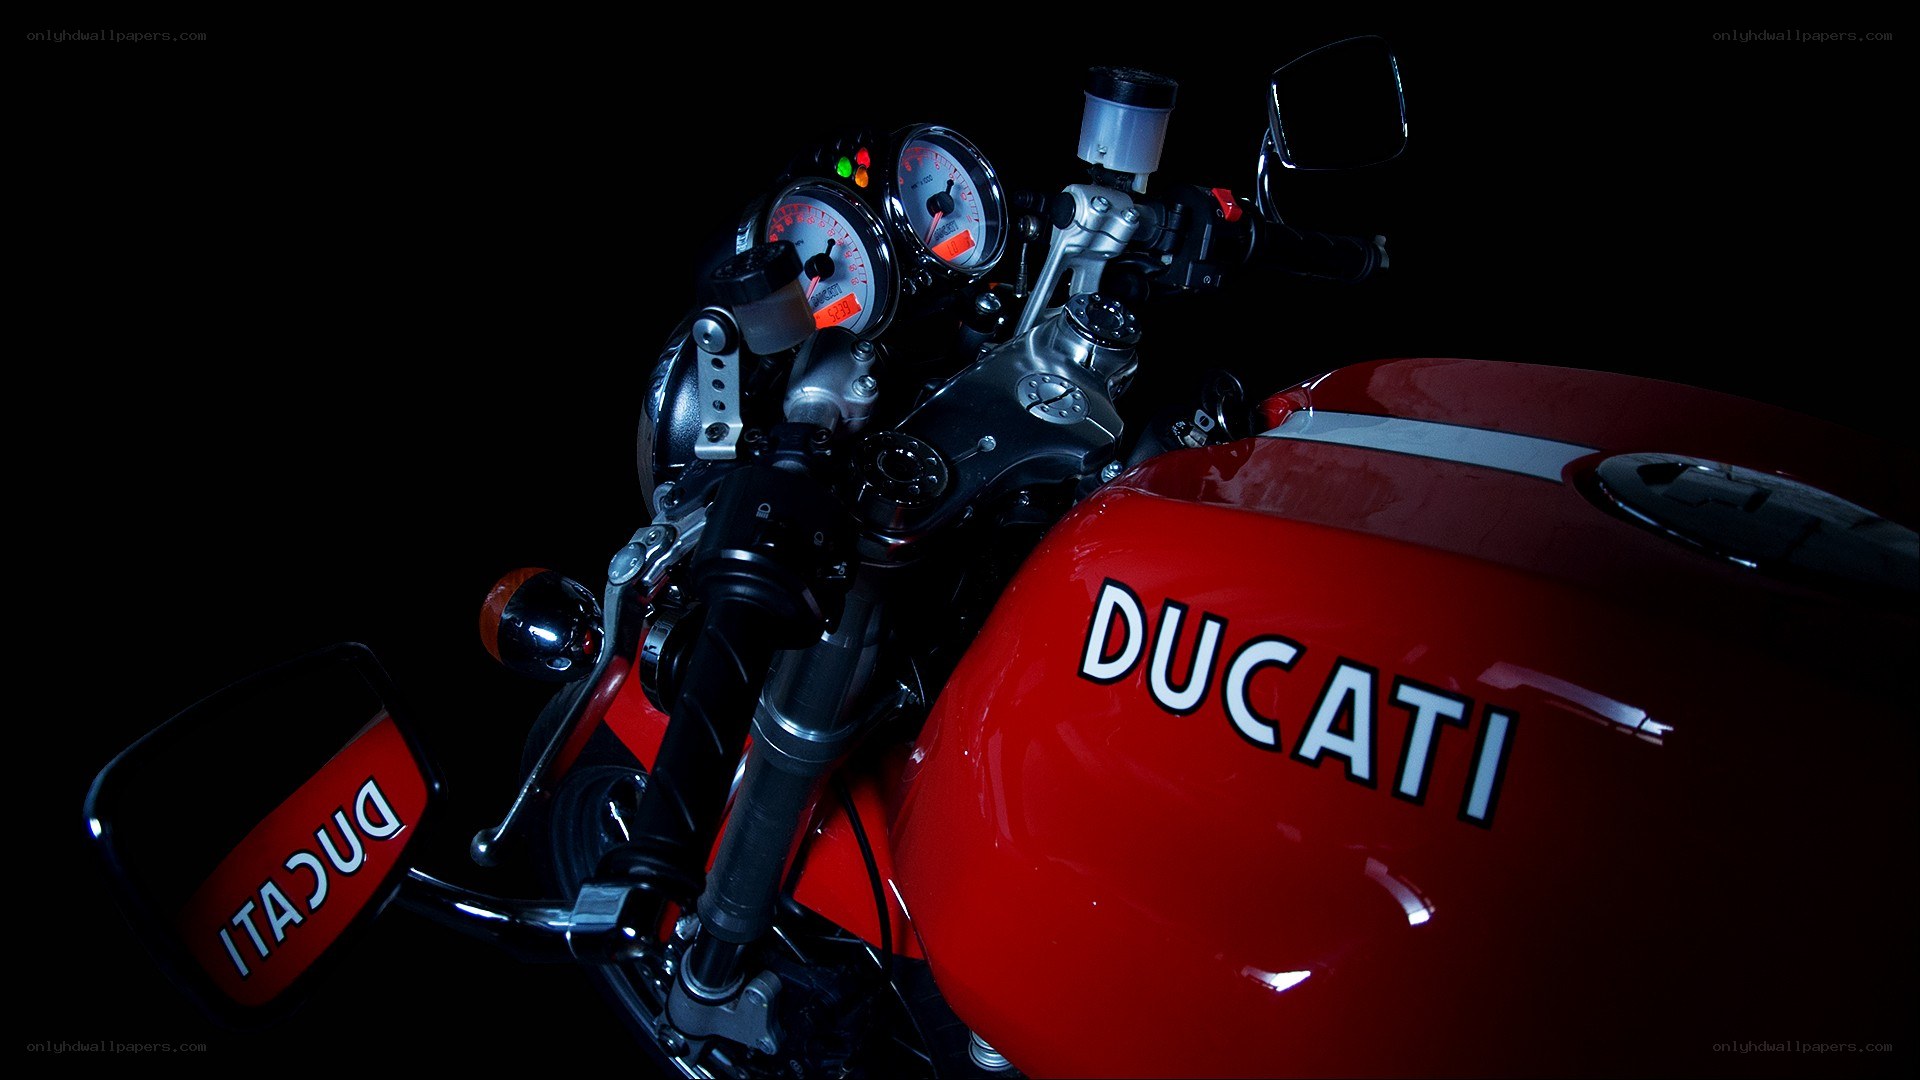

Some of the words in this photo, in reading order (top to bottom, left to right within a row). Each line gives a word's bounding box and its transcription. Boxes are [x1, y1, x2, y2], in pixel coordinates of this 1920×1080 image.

[812, 283, 843, 308] DUCATI
[827, 301, 851, 323] 5239
[1080, 580, 1517, 826] DUCATI
